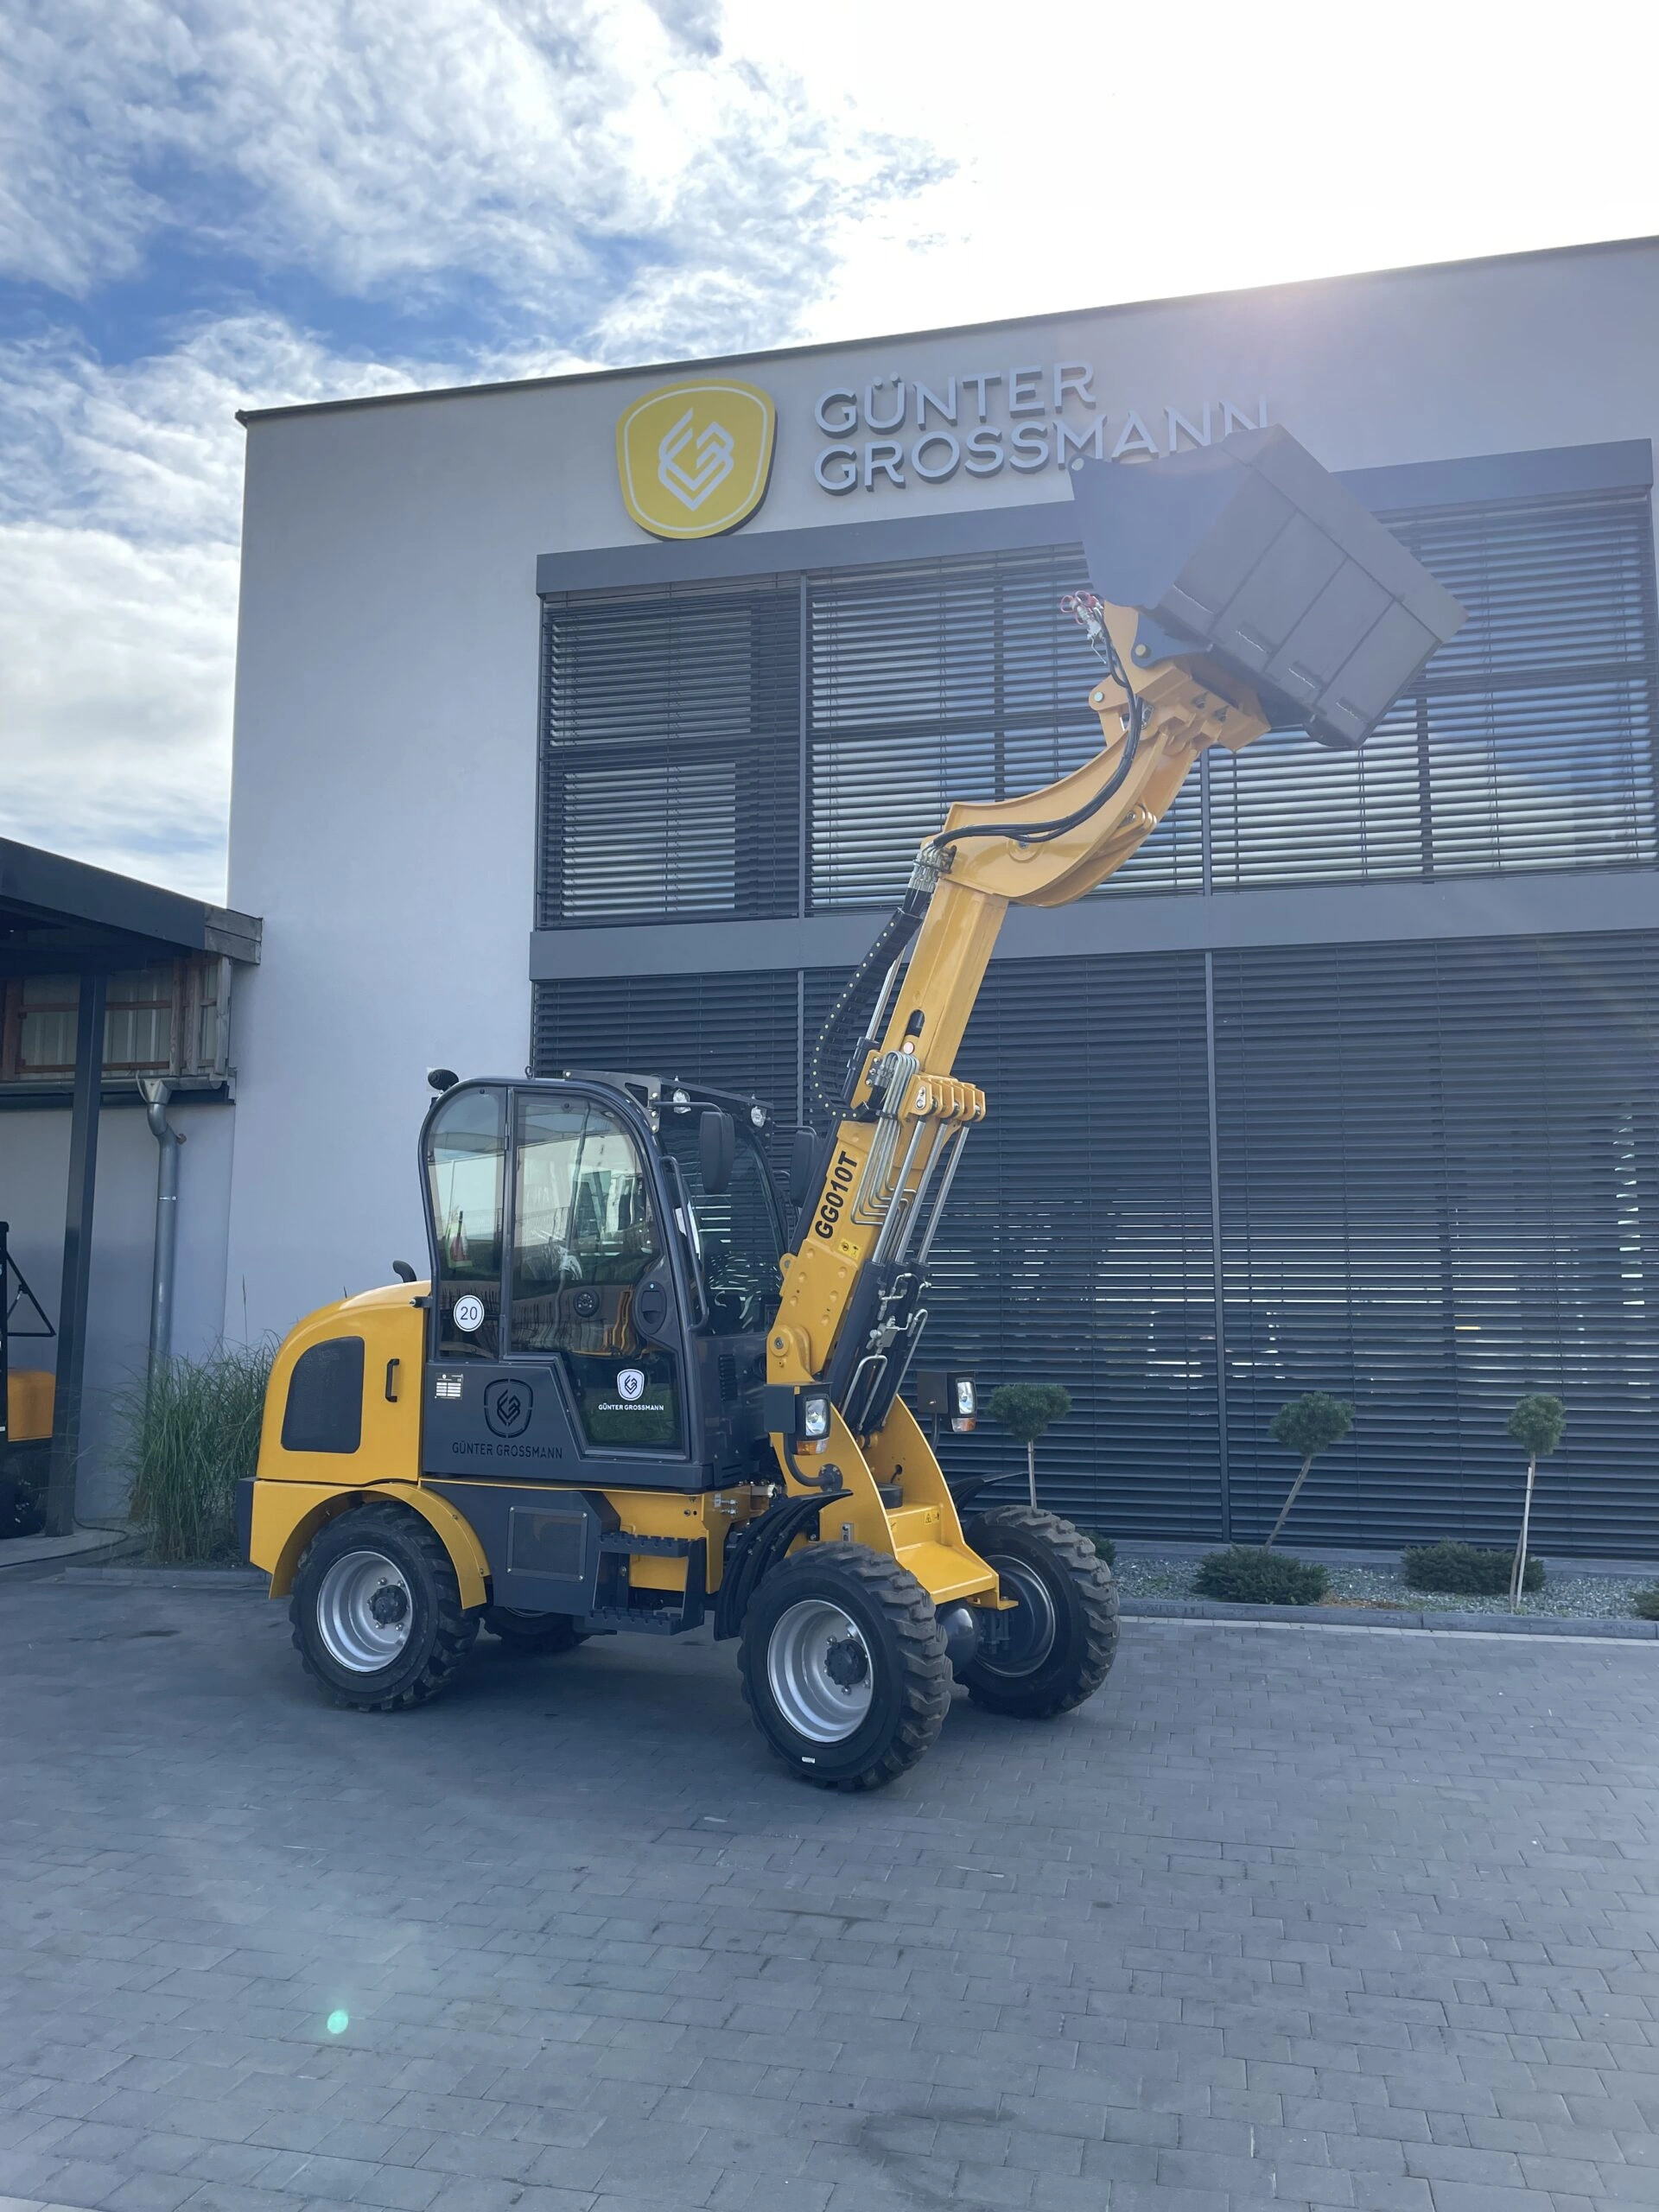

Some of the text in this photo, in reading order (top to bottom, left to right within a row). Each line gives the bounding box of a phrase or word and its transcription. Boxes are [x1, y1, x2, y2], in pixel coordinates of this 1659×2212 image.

[814, 360, 1096, 438] GÜNTER
[814, 393, 1268, 495] GROSSMANN
[815, 1151, 858, 1239] GG010T
[460, 1306, 479, 1321] 20
[452, 1440, 563, 1459] GÜNTER GROSSMANN
